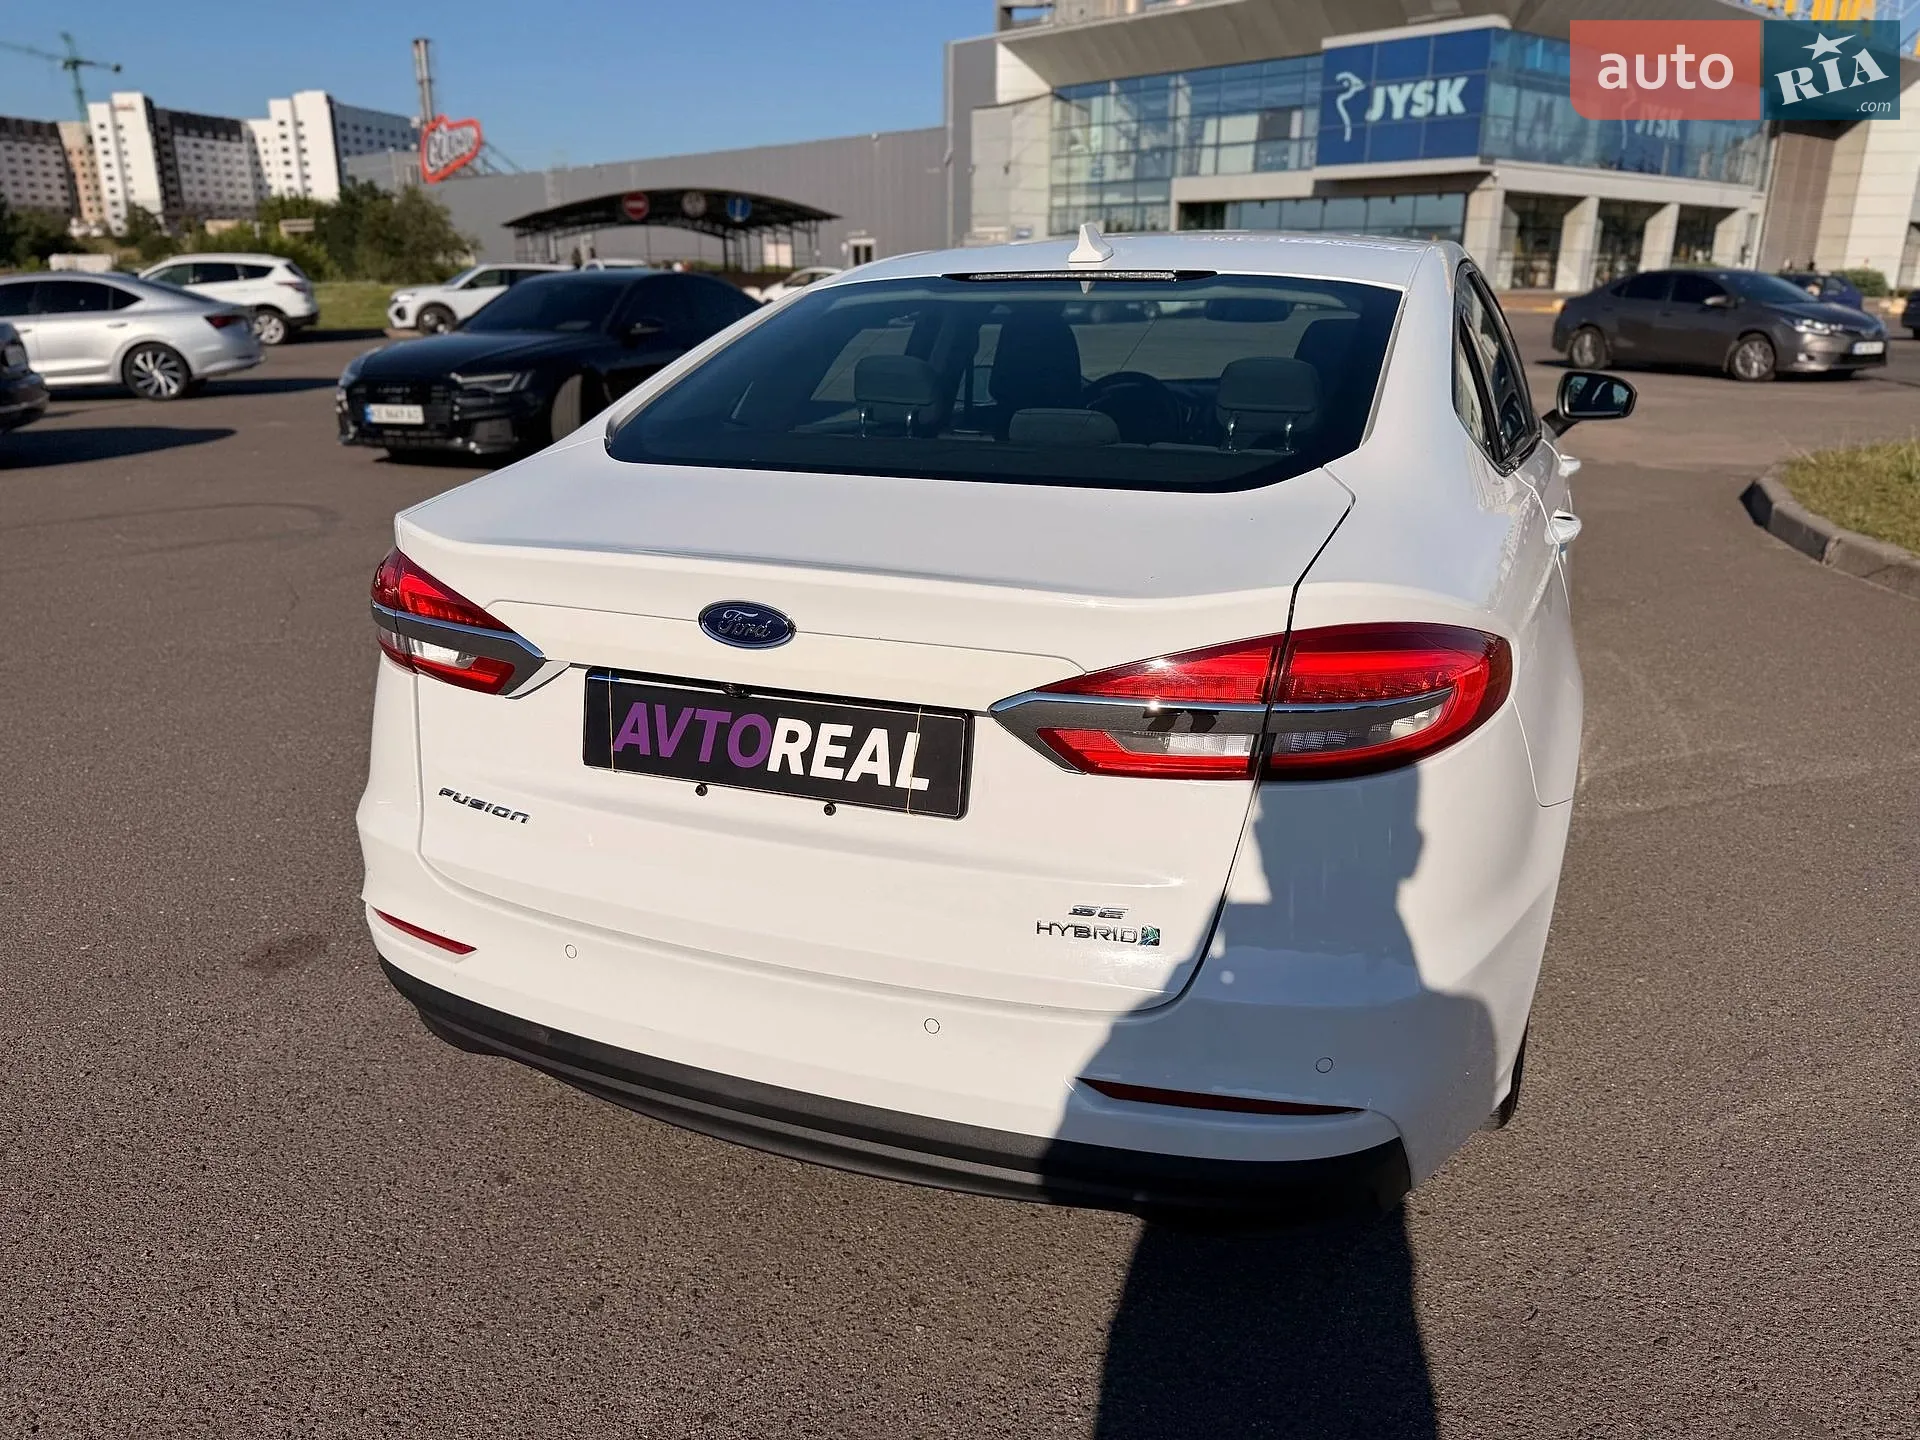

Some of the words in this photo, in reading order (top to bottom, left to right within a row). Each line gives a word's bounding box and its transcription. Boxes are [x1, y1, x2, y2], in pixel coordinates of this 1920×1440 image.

[1365, 76, 1469, 122] JYSK
[718, 608, 772, 639] Ford
[613, 701, 930, 792] AVTOREAL
[1068, 904, 1129, 920] SE
[1036, 919, 1138, 944] HYBRID
